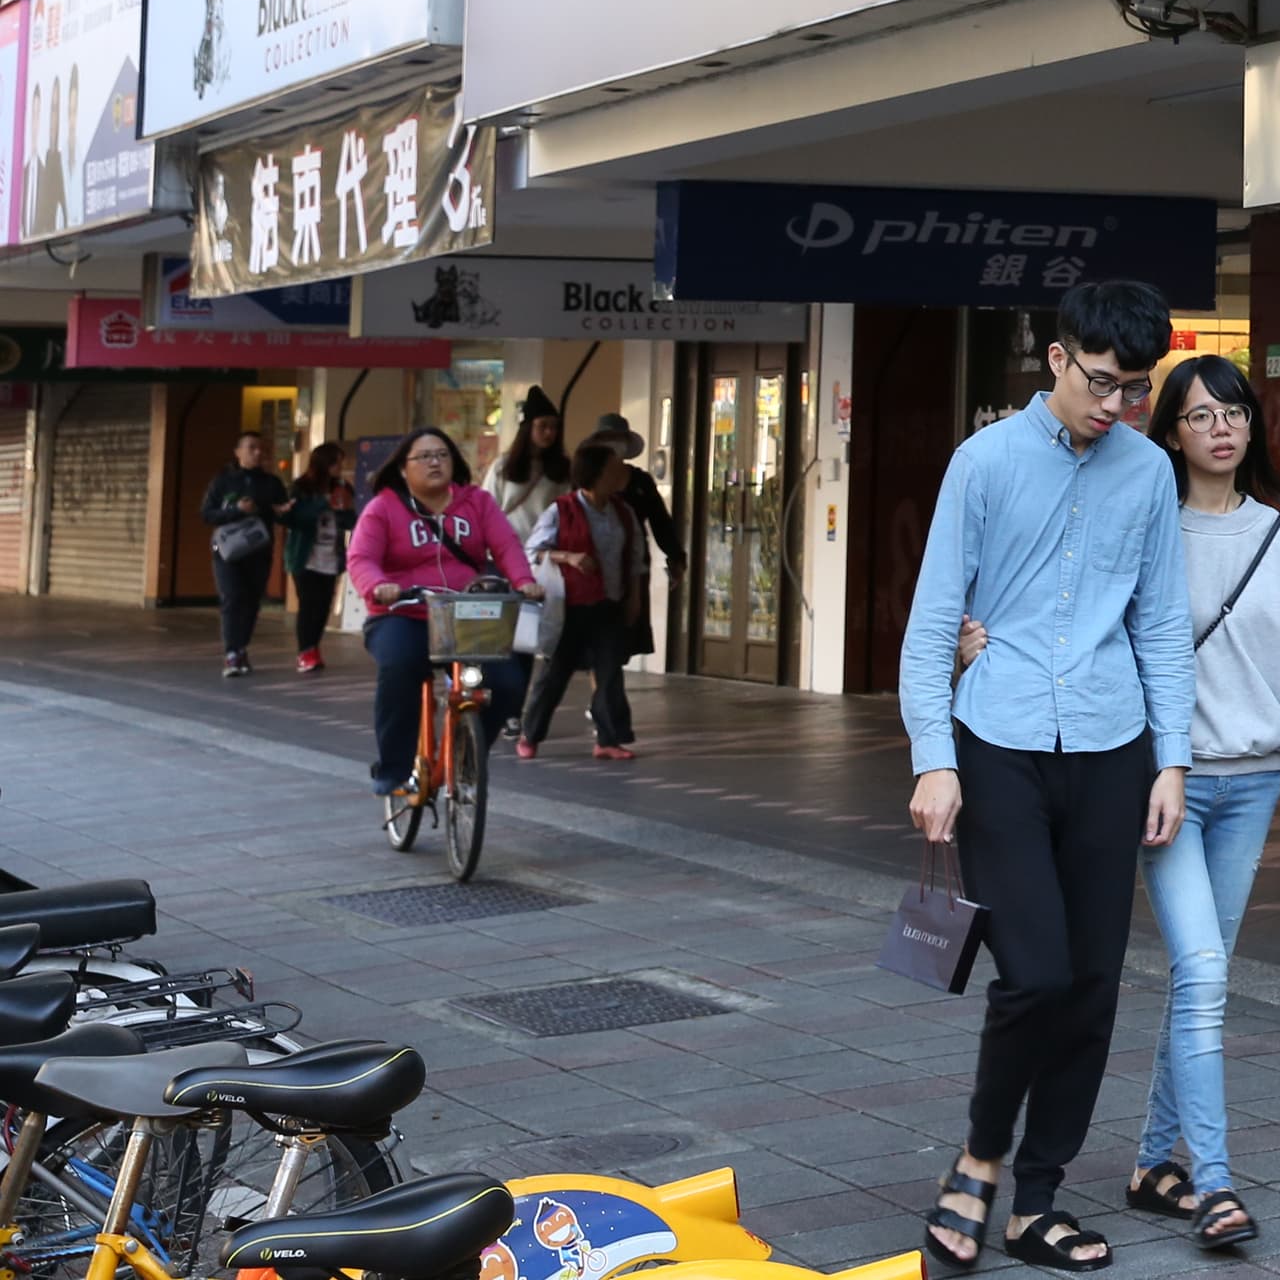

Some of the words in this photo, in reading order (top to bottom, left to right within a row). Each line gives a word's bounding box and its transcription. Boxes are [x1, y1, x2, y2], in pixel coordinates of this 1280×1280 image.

[264, 18, 352, 73] COLLECTION
[249, 116, 420, 274] 結束代理
[862, 210, 1097, 255] phiten
[979, 253, 1086, 289] 銀谷
[563, 282, 644, 313] Black
[581, 316, 735, 331] COLLECTION
[218, 1094, 245, 1103] VELO
[273, 1249, 305, 1259] VELO
